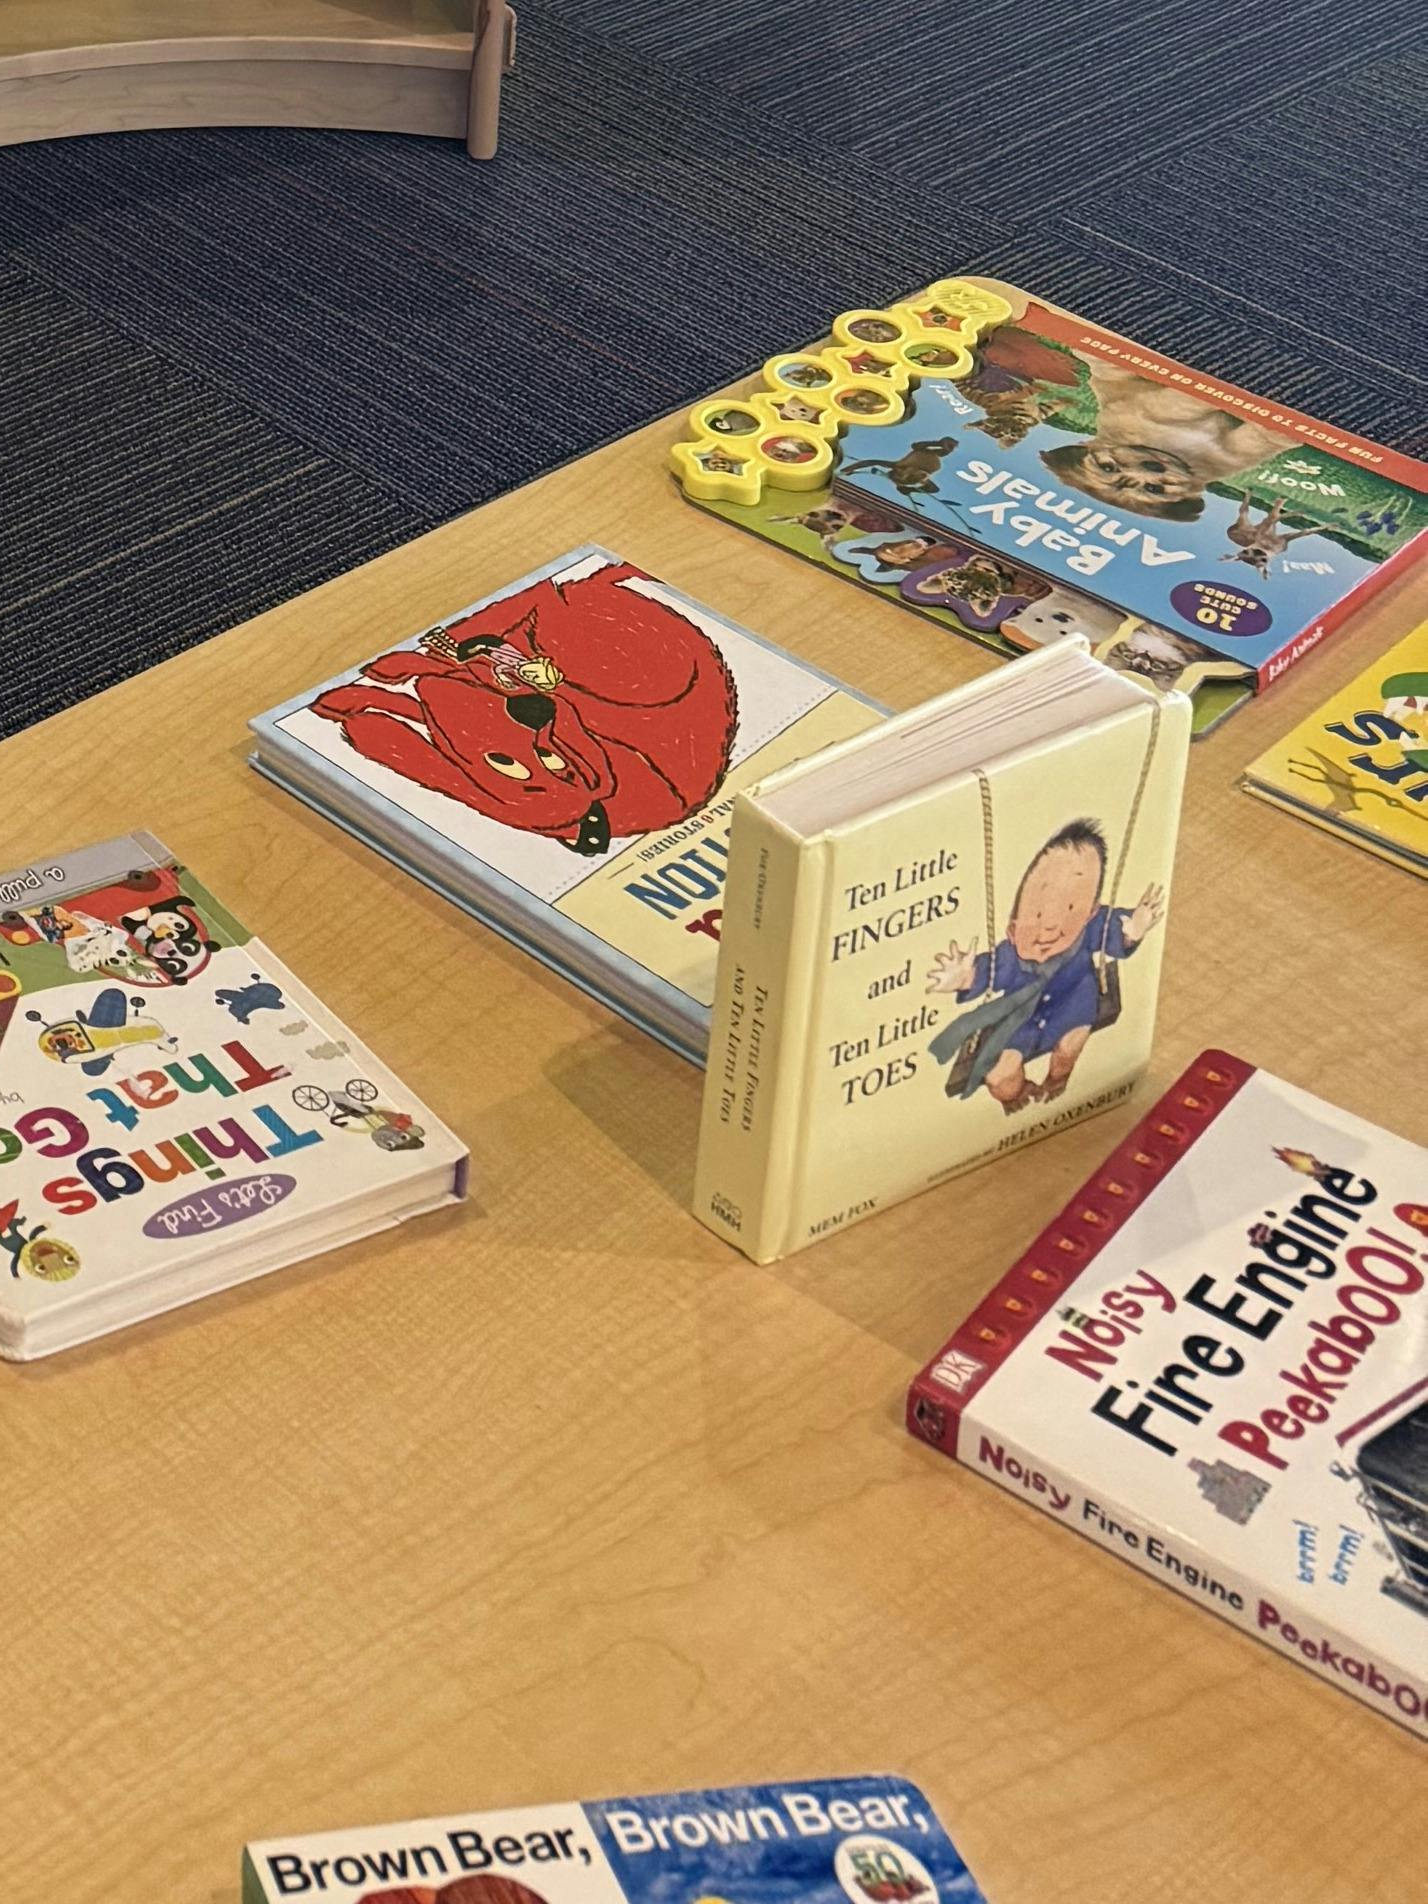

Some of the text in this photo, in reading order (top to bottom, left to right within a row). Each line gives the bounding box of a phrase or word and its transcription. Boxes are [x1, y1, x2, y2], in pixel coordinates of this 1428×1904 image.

[1193, 381, 1270, 416] DISCOVER
[1271, 413, 1295, 429] TO
[1293, 425, 1348, 452] FACTS
[1349, 444, 1384, 464] FUN
[1256, 469, 1347, 498] Woof!
[955, 459, 1196, 567] Animals
[969, 499, 1116, 577] Baby
[1193, 581, 1258, 611] SOUNDS
[1196, 606, 1238, 632] 10
[1199, 594, 1242, 616] CUTE
[636, 819, 705, 863] STORIES!
[45, 866, 66, 882] a
[844, 849, 958, 912] Ten Little
[831, 885, 961, 963] FINGERS
[867, 959, 912, 1000] and
[829, 1004, 939, 1069] Ten Little
[87, 1039, 293, 1132] That
[841, 1051, 918, 1106] TOES
[43, 1104, 324, 1215] Things
[158, 1177, 287, 1234] Let's Find
[1045, 1269, 1177, 1383] Noisy
[1091, 1167, 1379, 1457] Fire Engine
[932, 1350, 980, 1389] DK
[978, 1434, 1428, 1720] Noisy Fire Engine PeekabO
[604, 1793, 929, 1856] Brown Bear,
[266, 1820, 592, 1897] Brown Bear,
